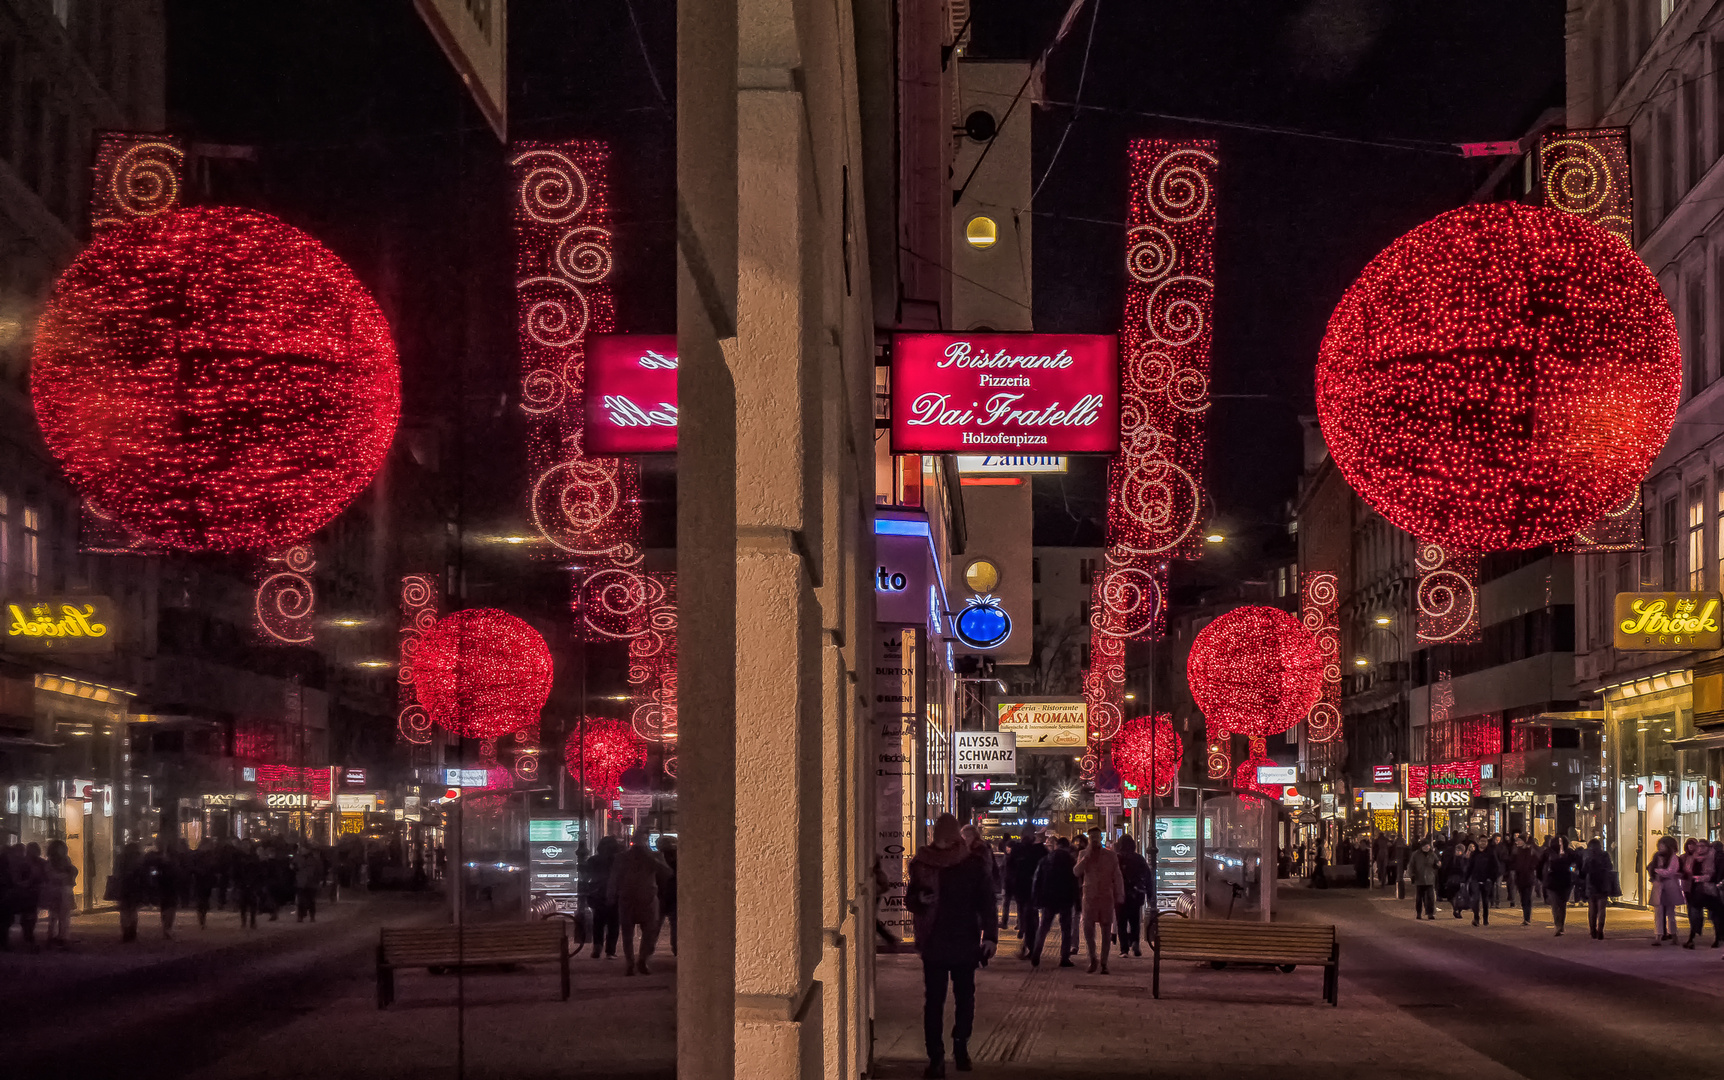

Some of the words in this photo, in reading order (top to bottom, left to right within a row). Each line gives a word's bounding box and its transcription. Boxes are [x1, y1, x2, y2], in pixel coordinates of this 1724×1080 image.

[937, 341, 1074, 369] Ristorante
[979, 374, 1031, 387] Pizzeria
[907, 392, 978, 426] Dai
[976, 392, 1104, 427] Fratelli
[962, 432, 1048, 447] Holzofenpizza
[1620, 598, 1719, 634] Ströck
[1645, 635, 1696, 644] BROT
[875, 667, 914, 675] BURTON
[1032, 712, 1085, 724] ROMANA
[958, 736, 999, 747] ALYSSA
[958, 750, 1013, 761] SCHWARZ
[990, 791, 1003, 805] Le
[1002, 791, 1030, 806] Burger
[1431, 791, 1470, 803] BOSS
